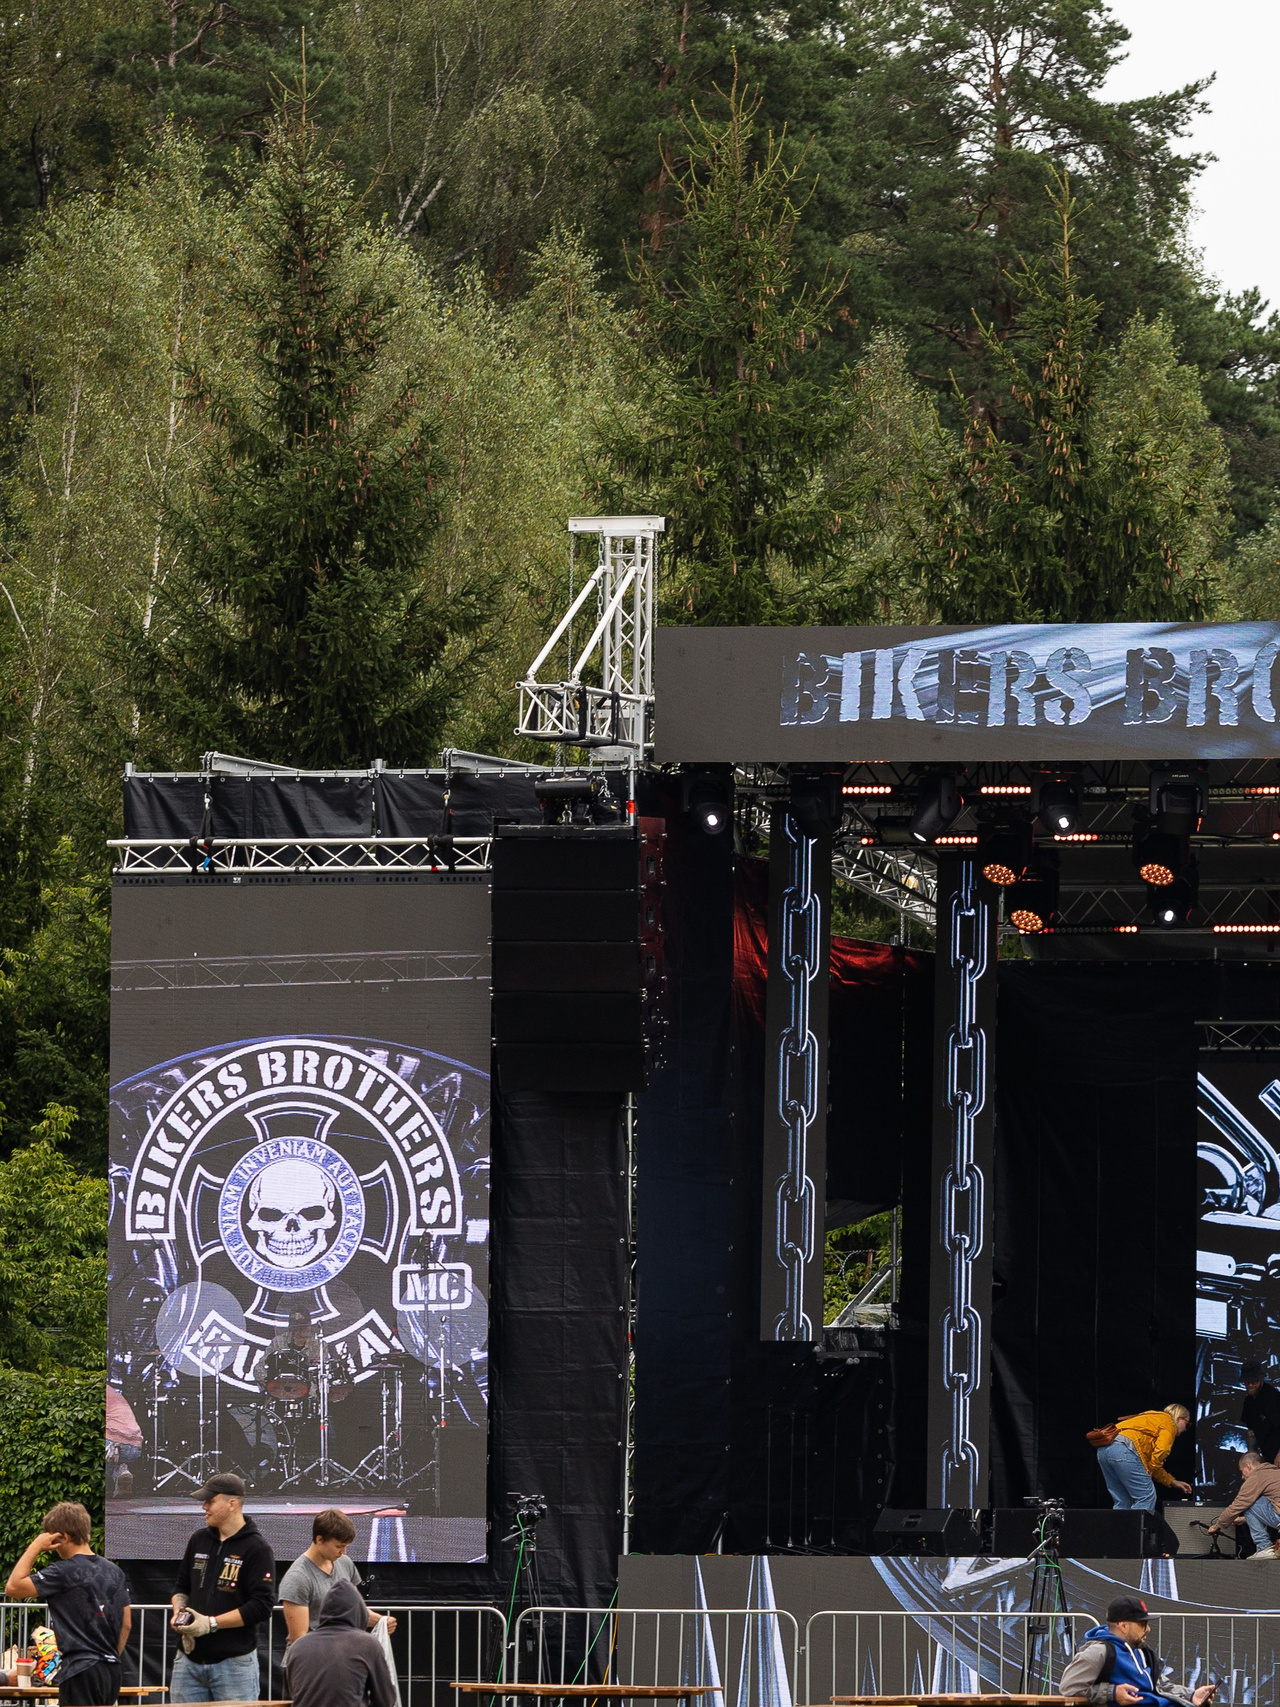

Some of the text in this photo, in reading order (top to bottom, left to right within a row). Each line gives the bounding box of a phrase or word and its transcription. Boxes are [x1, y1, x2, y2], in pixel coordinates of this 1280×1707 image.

[779, 646, 1093, 728] BIKERS
[135, 1049, 452, 1230] BIKERS BROTHERS
[229, 1243, 264, 1276] AUT
[327, 1161, 359, 1196] AUT
[406, 1272, 460, 1301] MC
